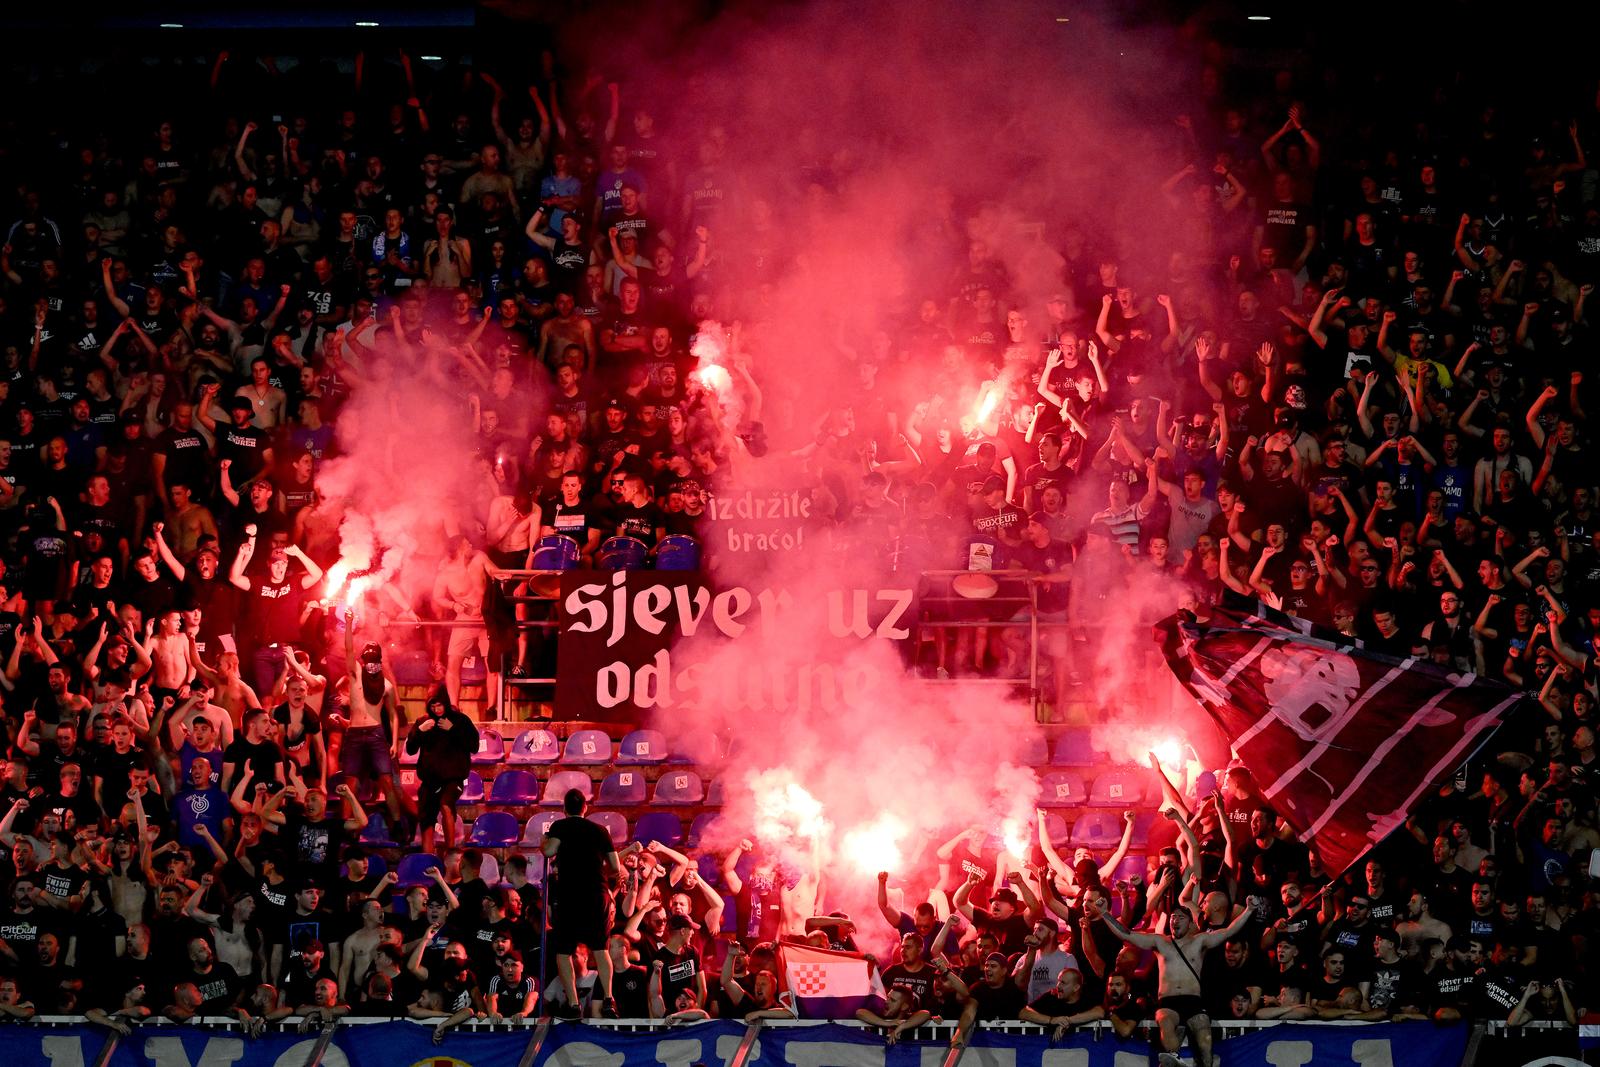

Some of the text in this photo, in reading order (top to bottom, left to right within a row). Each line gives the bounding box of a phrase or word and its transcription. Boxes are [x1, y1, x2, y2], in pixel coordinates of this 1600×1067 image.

[709, 490, 811, 521] izdržite
[1177, 504, 1206, 520] DINAMO
[977, 514, 1018, 530] BOXEUR
[727, 527, 804, 552] braćo!
[565, 570, 914, 647] sjever uz
[1, 926, 37, 935] Pitbull
[1438, 978, 1462, 987] sjever
[1486, 982, 1519, 1006] sjever uz
